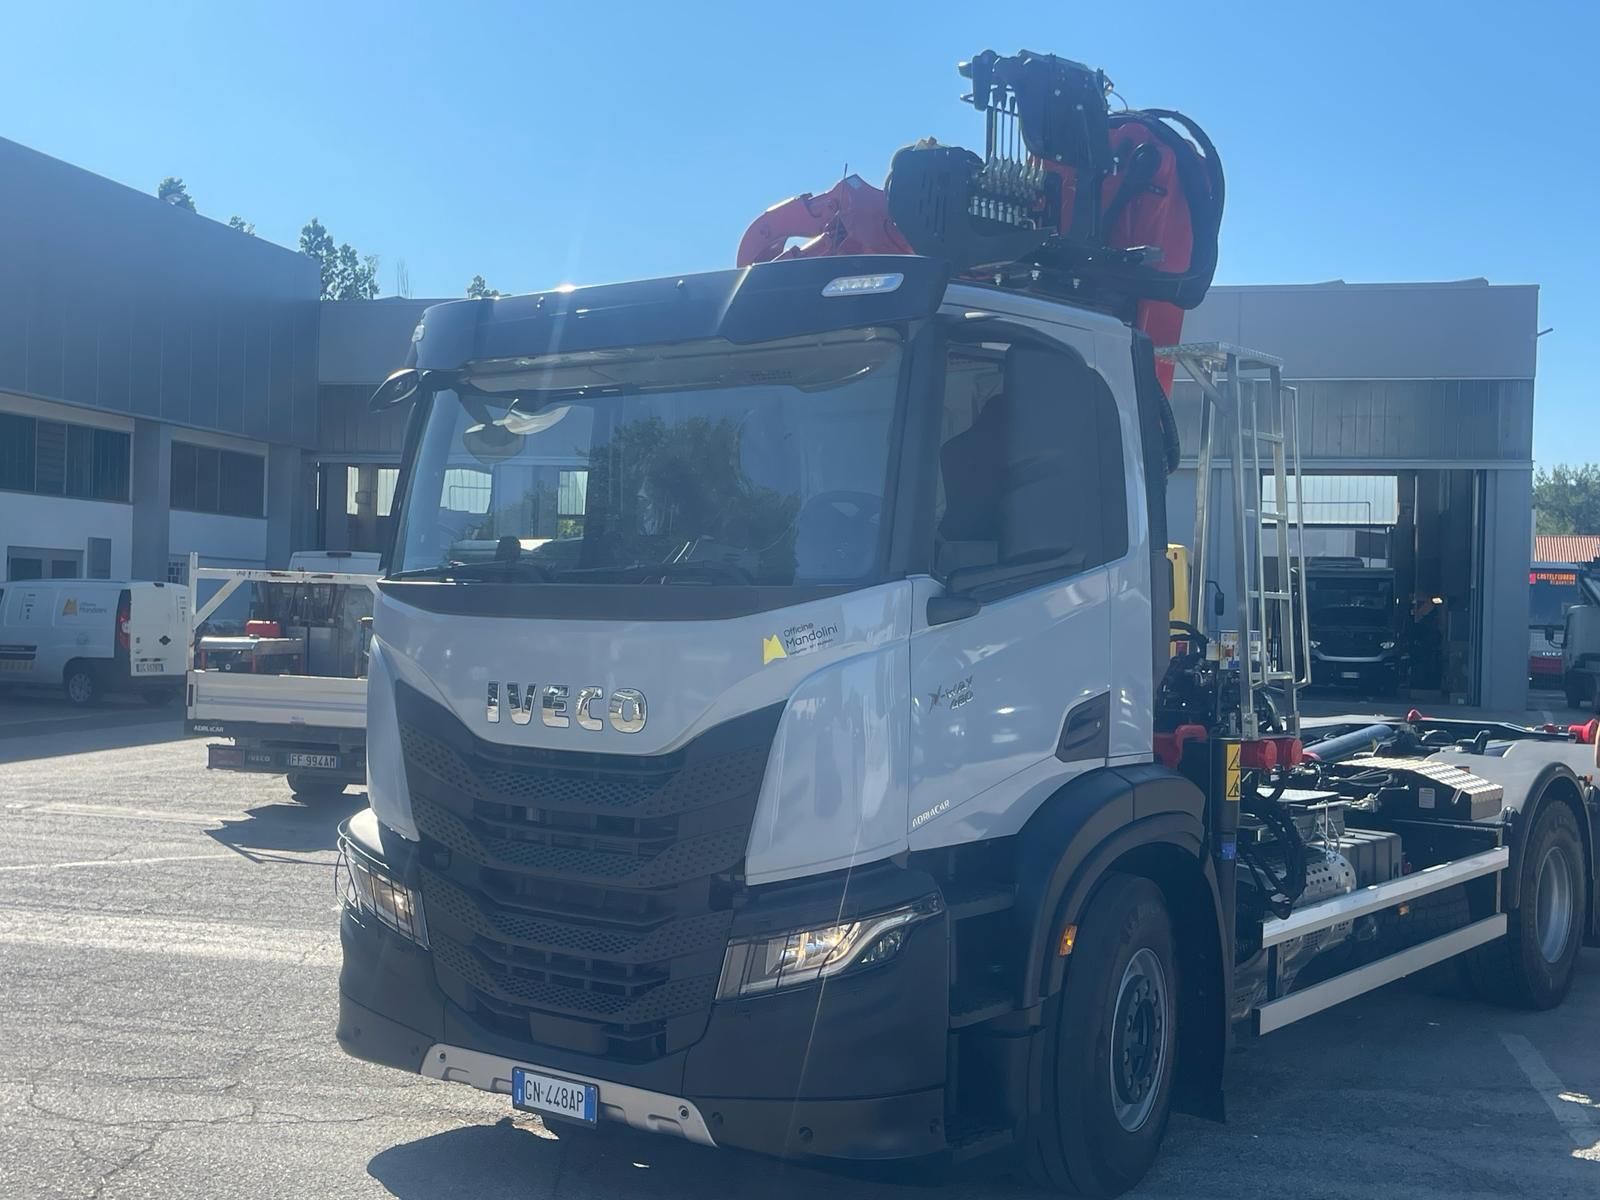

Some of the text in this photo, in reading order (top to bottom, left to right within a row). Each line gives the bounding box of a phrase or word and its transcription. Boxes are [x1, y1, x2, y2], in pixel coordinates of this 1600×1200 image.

[784, 622, 814, 637] Officine
[785, 624, 838, 648] Mandolini
[487, 681, 648, 734] IVECO
[912, 800, 951, 828] ADRIACAR
